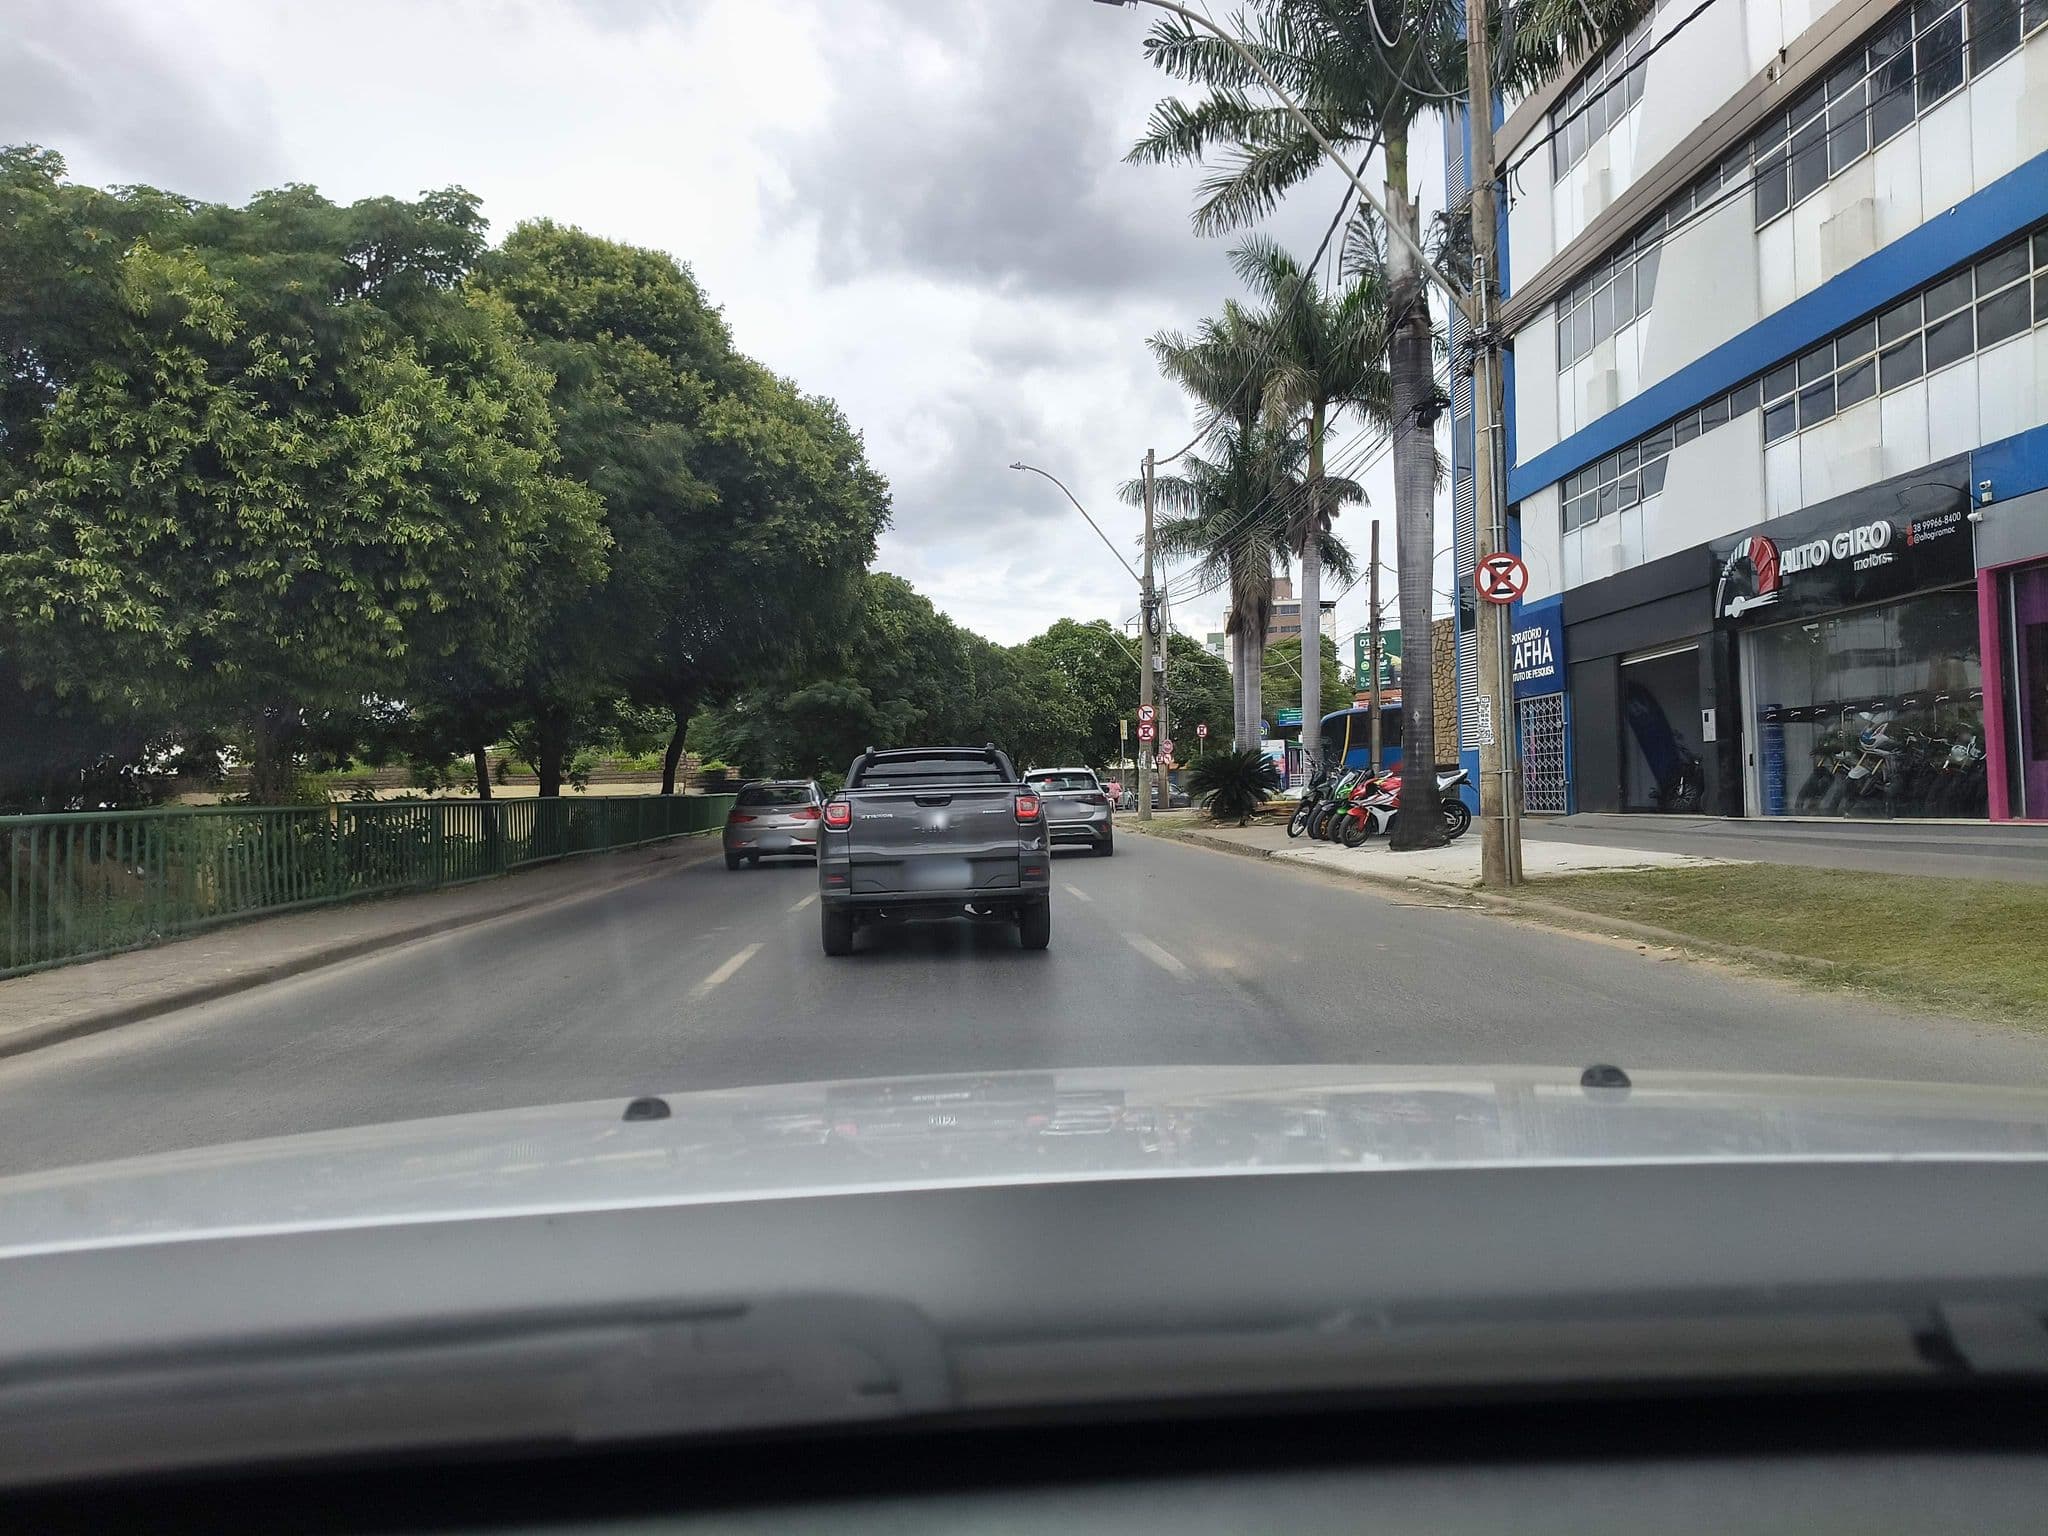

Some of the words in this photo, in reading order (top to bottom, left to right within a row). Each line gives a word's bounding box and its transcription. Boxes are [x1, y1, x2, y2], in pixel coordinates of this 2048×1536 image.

[1912, 522, 1922, 533] 38
[1922, 511, 1962, 530] 99966-8400
[1779, 540, 1831, 577] ALTO
[1831, 520, 1892, 560] GIRO
[1853, 552, 1893, 571] motors
[1511, 626, 1542, 645] BORATÓRIO
[1514, 629, 1554, 671] AFHÁ
[1526, 669, 1532, 680] DE
[1532, 665, 1555, 678] PESQUISA
